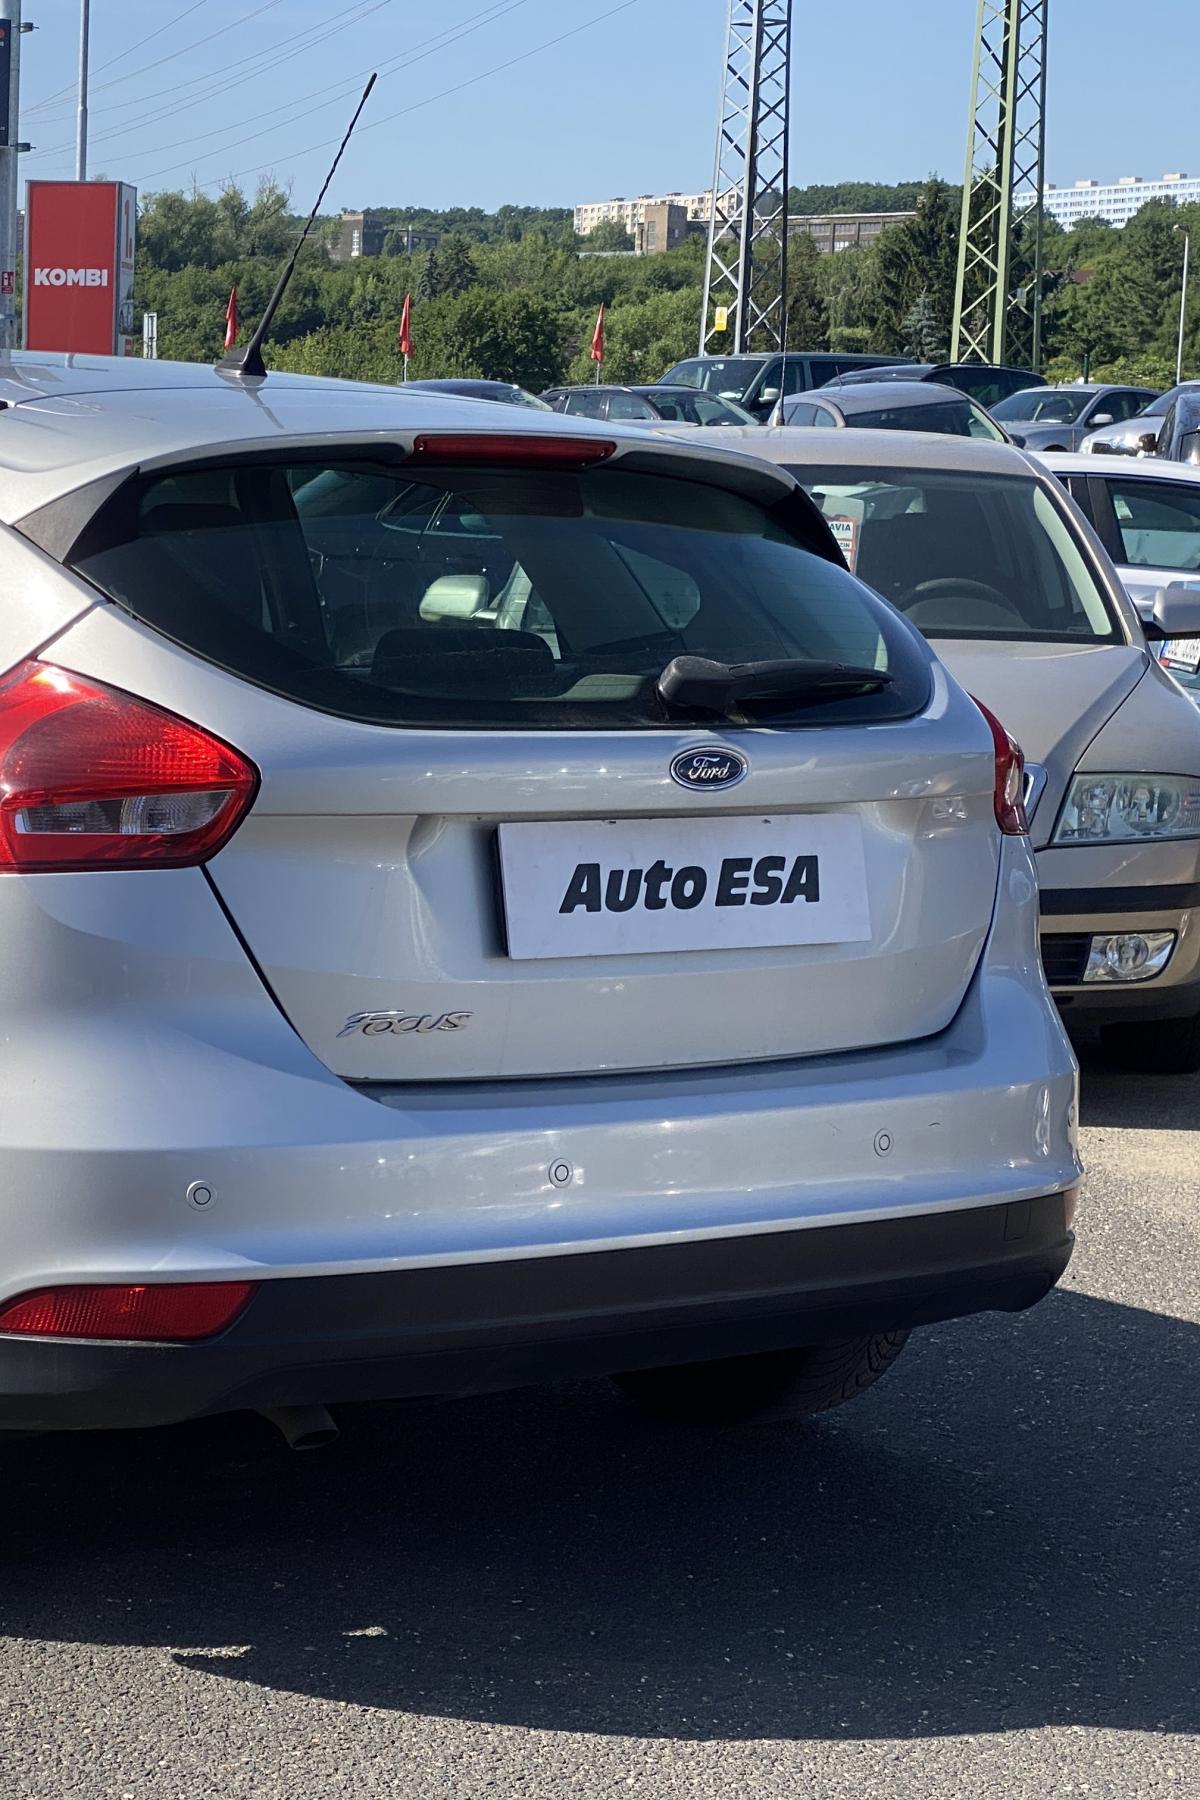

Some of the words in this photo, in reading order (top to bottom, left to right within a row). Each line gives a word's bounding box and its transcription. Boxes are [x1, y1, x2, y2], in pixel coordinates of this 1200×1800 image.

[34, 268, 108, 287] KOMBI
[688, 756, 731, 779] Ford
[558, 859, 708, 914] Auto
[714, 855, 820, 907] ESA
